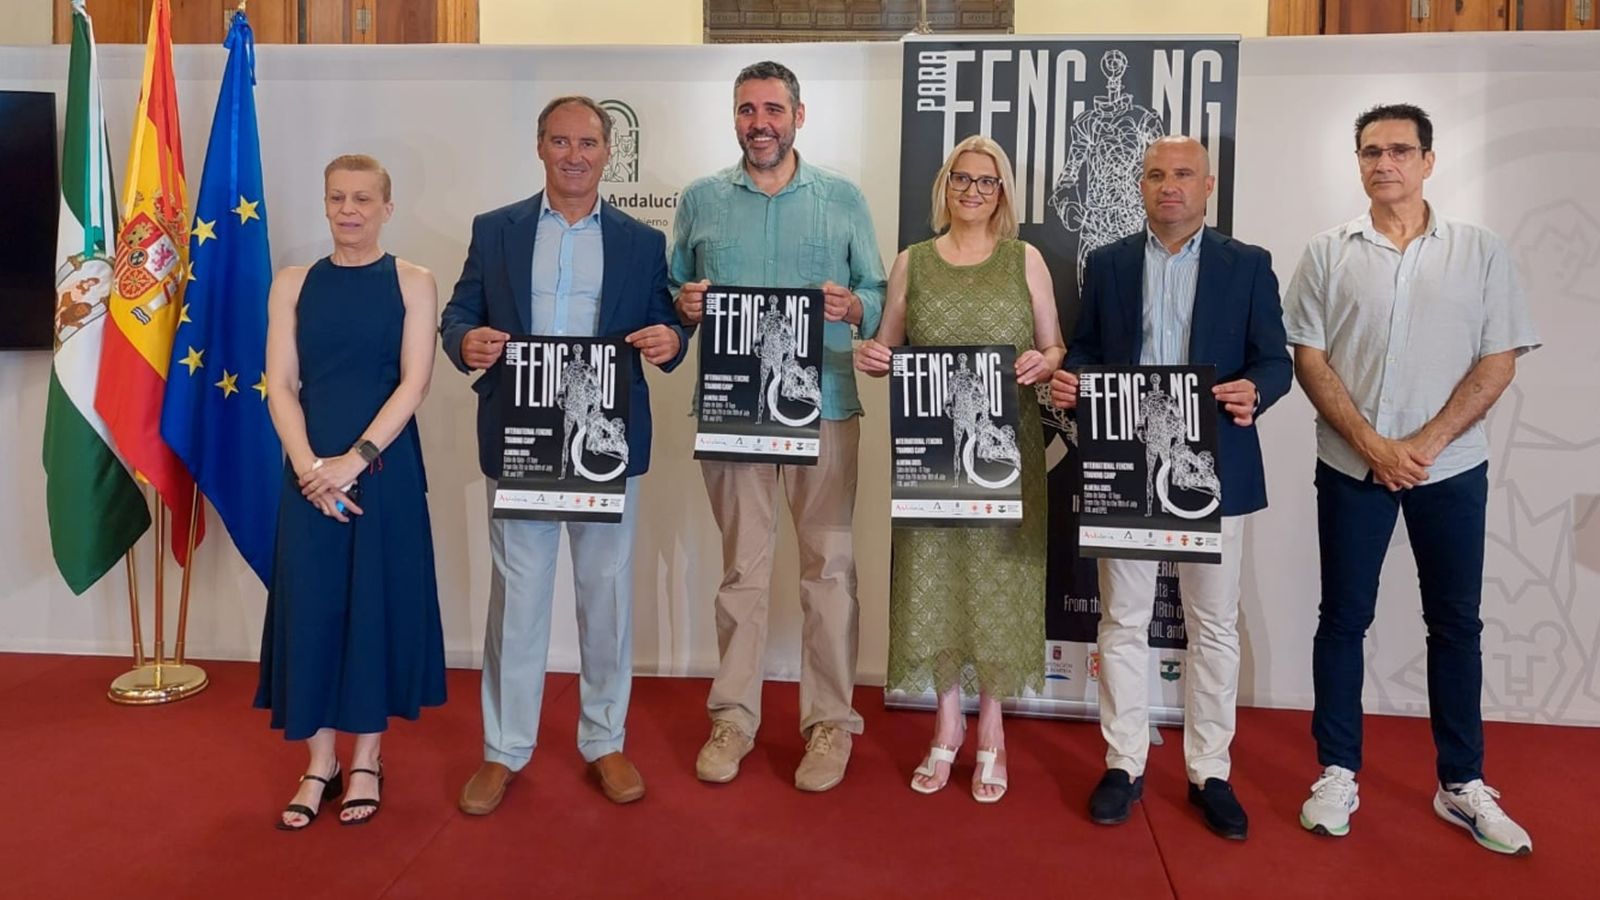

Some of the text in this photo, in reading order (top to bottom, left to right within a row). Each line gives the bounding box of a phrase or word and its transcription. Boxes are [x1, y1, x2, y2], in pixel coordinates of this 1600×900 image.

[917, 51, 947, 112] PARA
[608, 192, 678, 208] Andalucí
[1064, 594, 1100, 614] From th
[1150, 620, 1164, 638] OIL
